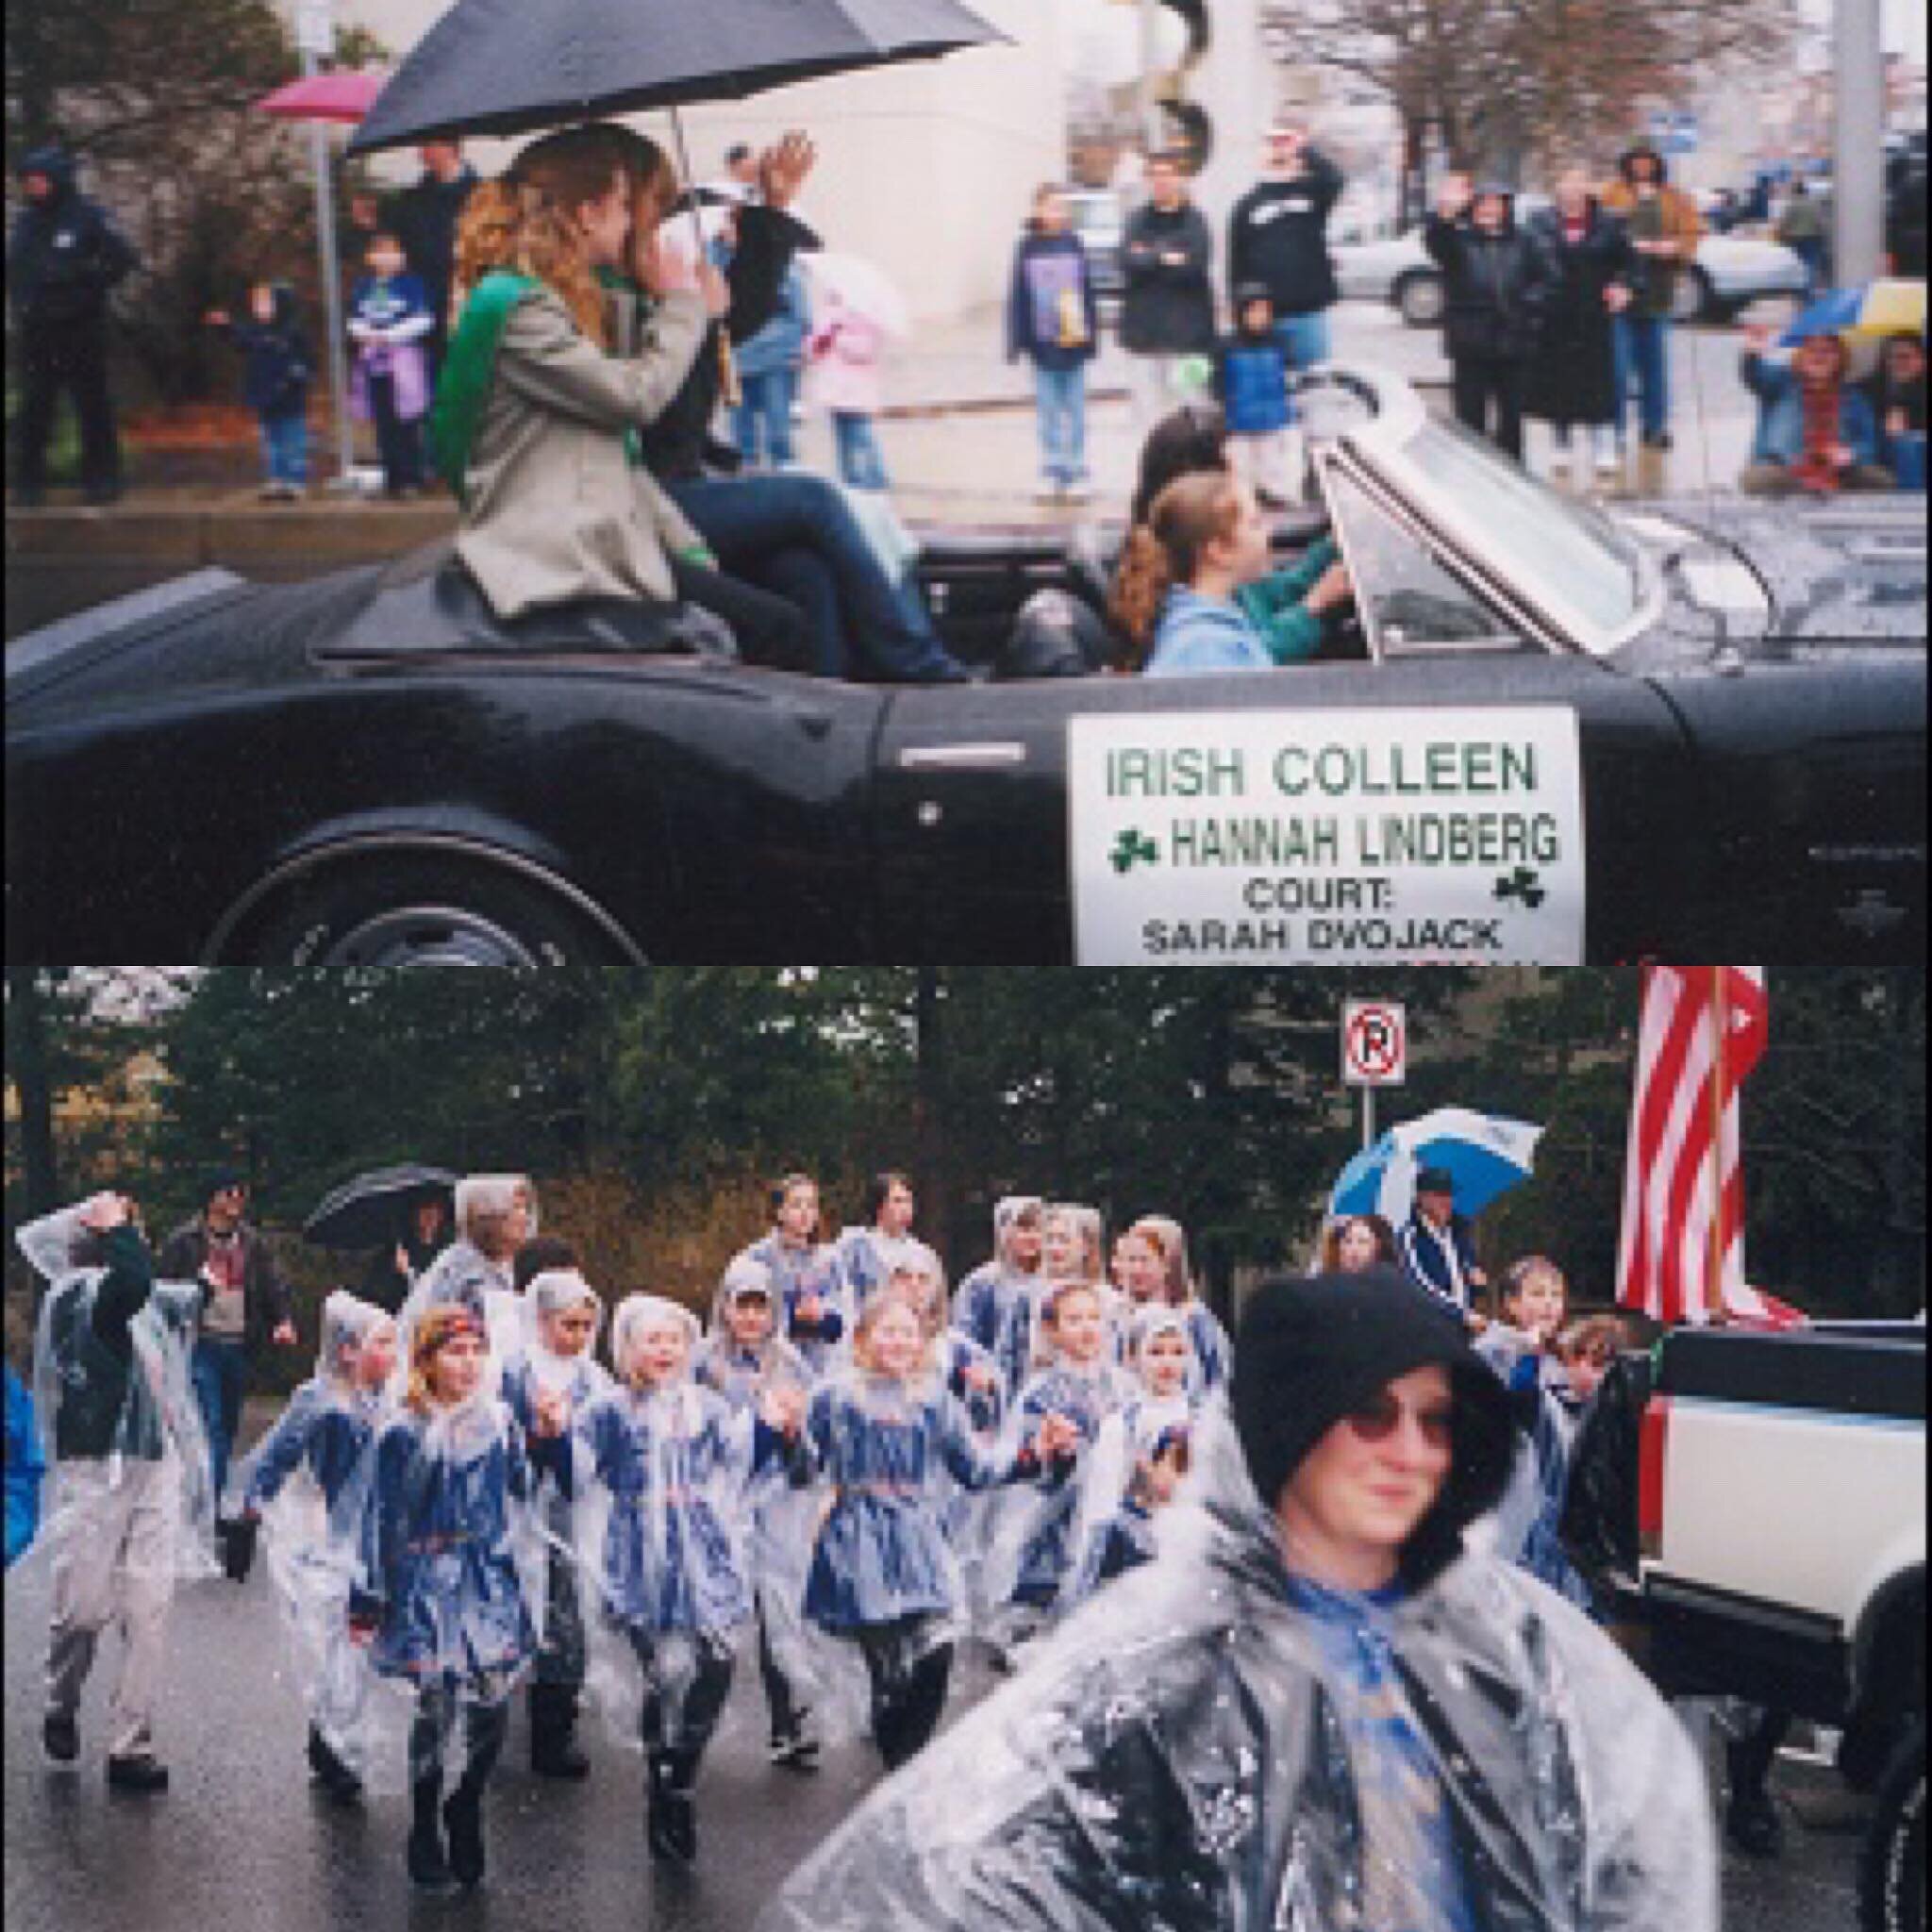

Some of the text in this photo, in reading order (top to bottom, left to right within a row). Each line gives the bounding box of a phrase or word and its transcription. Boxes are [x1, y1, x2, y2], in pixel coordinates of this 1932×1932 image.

[1107, 742, 1539, 796] IRISH COLLEEN
[1172, 812, 1559, 866] HANNAH LINDBERG
[1243, 877, 1393, 911] COURT:
[1142, 919, 1504, 954] SARAH DVOJACK
